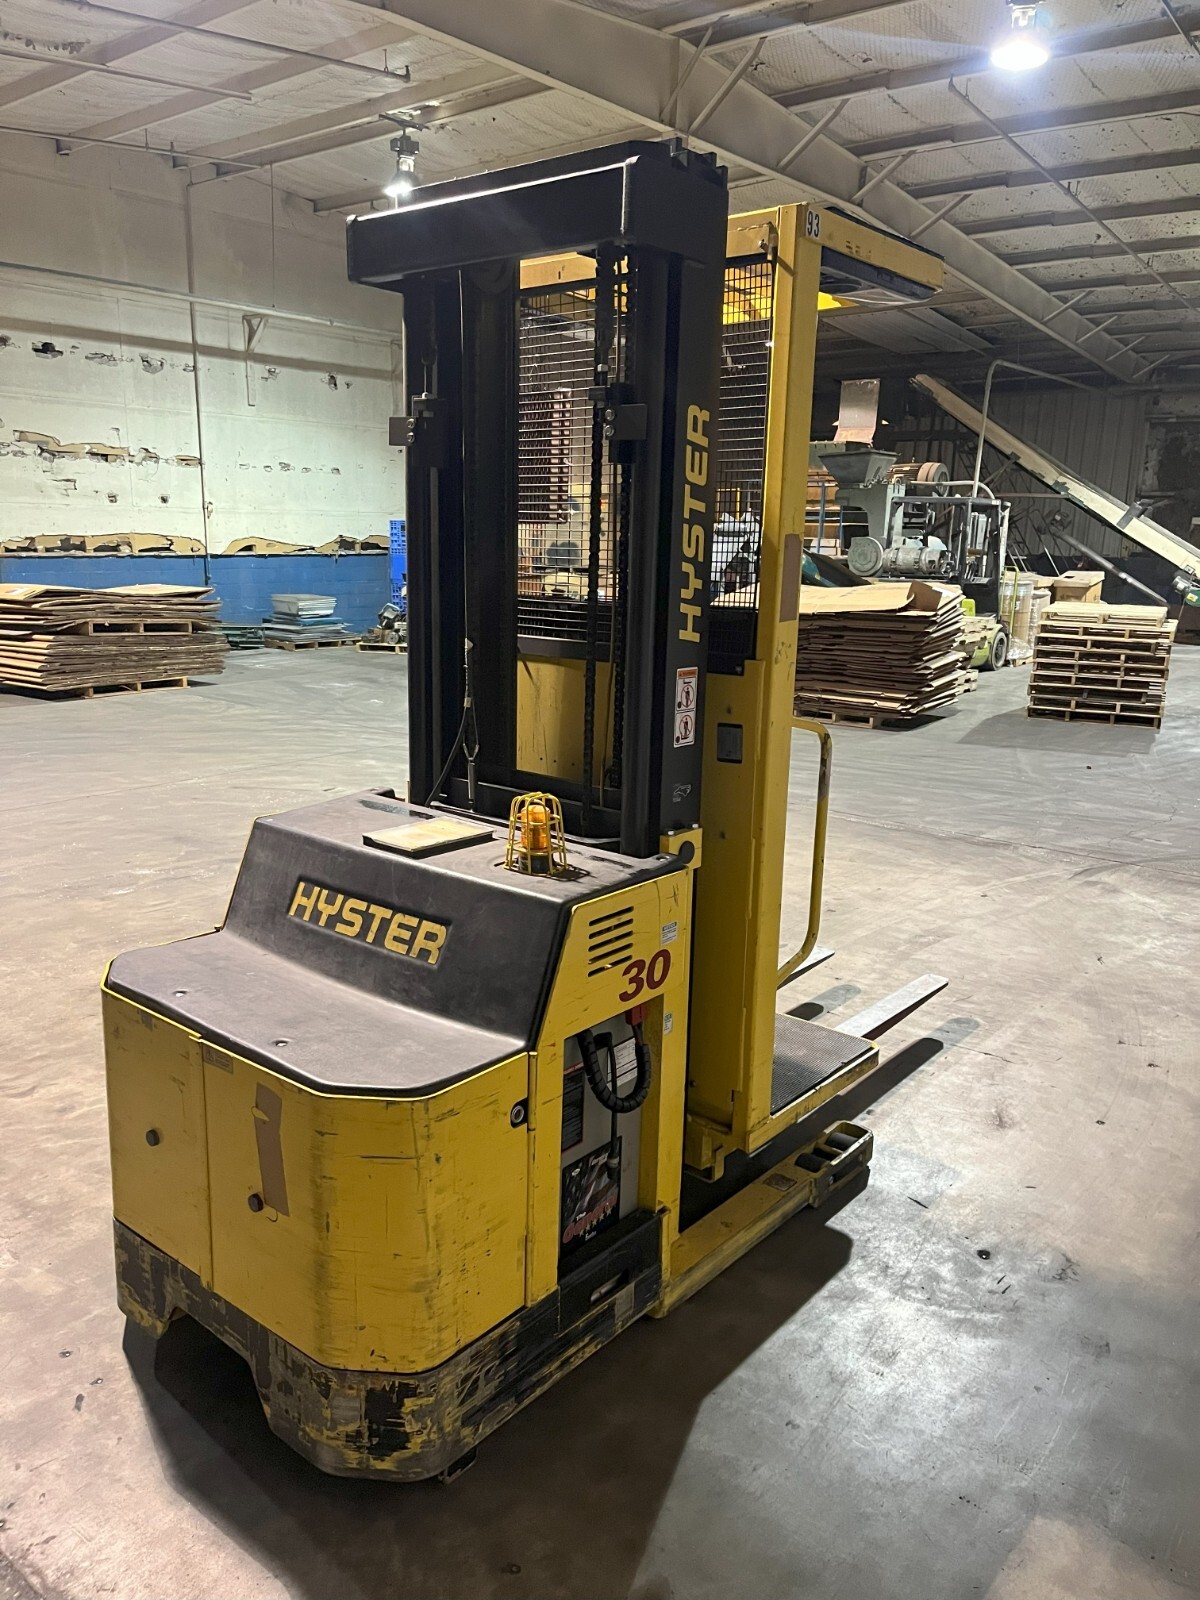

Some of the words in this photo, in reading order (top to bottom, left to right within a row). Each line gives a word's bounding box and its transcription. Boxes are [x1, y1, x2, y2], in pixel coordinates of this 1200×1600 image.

[807, 210, 820, 238] 93
[679, 404, 710, 643] HYSTER
[288, 881, 447, 965] HYSTER
[618, 948, 672, 1003] 30
